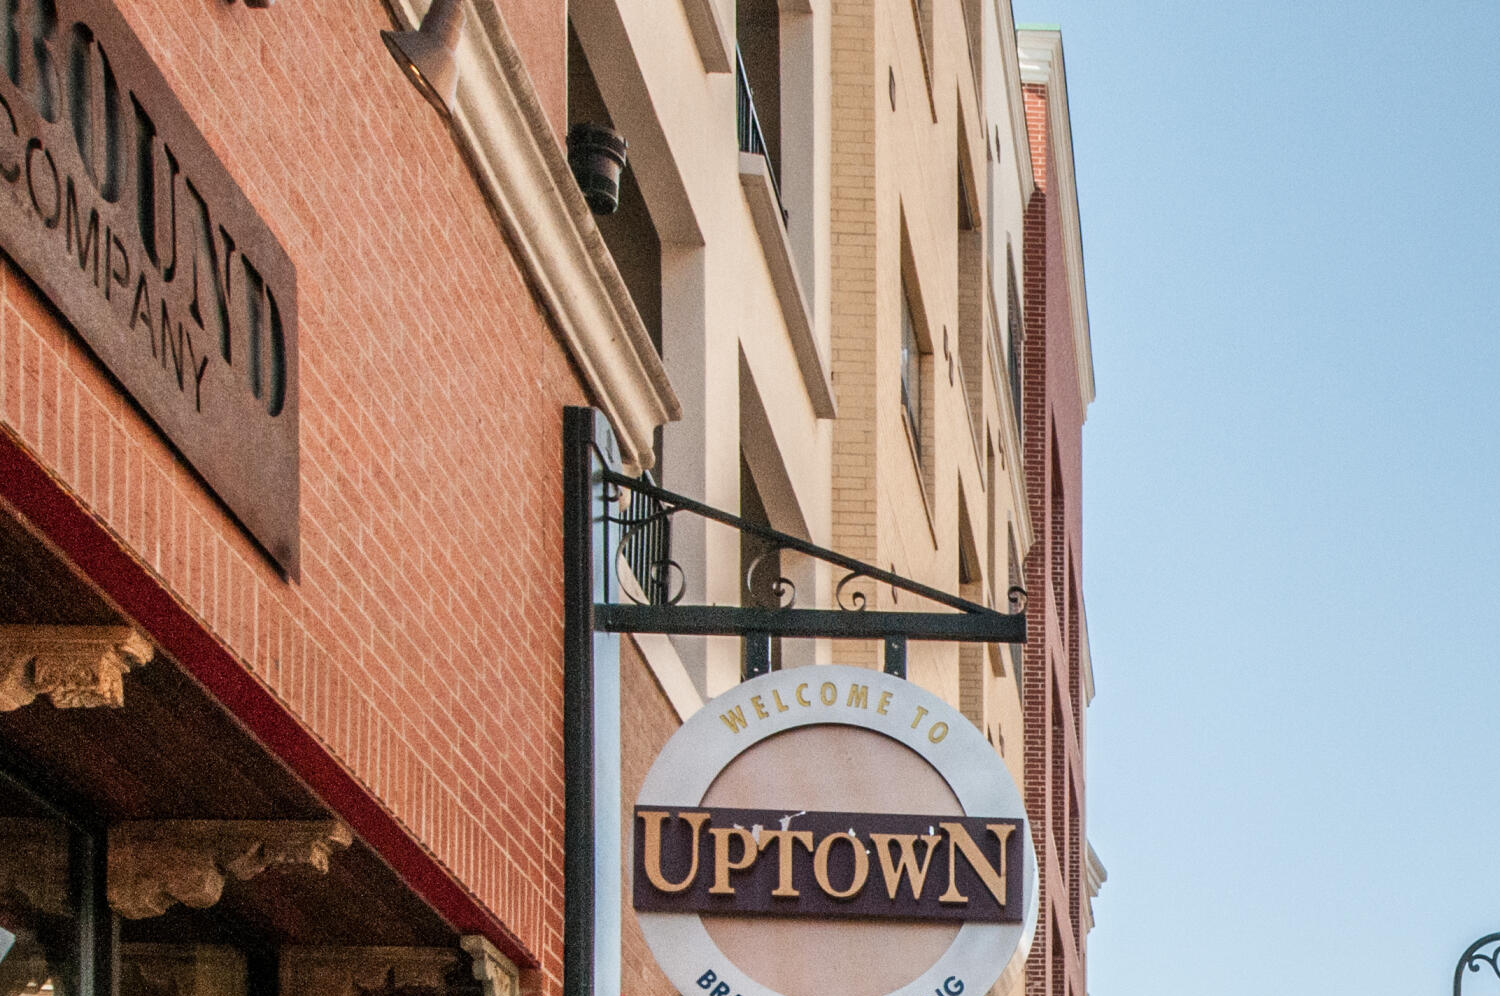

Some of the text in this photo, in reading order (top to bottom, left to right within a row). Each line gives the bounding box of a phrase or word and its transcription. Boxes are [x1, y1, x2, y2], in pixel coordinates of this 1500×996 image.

[719, 681, 950, 745] WELCOME TO
[637, 810, 1017, 907] UPTOWN
